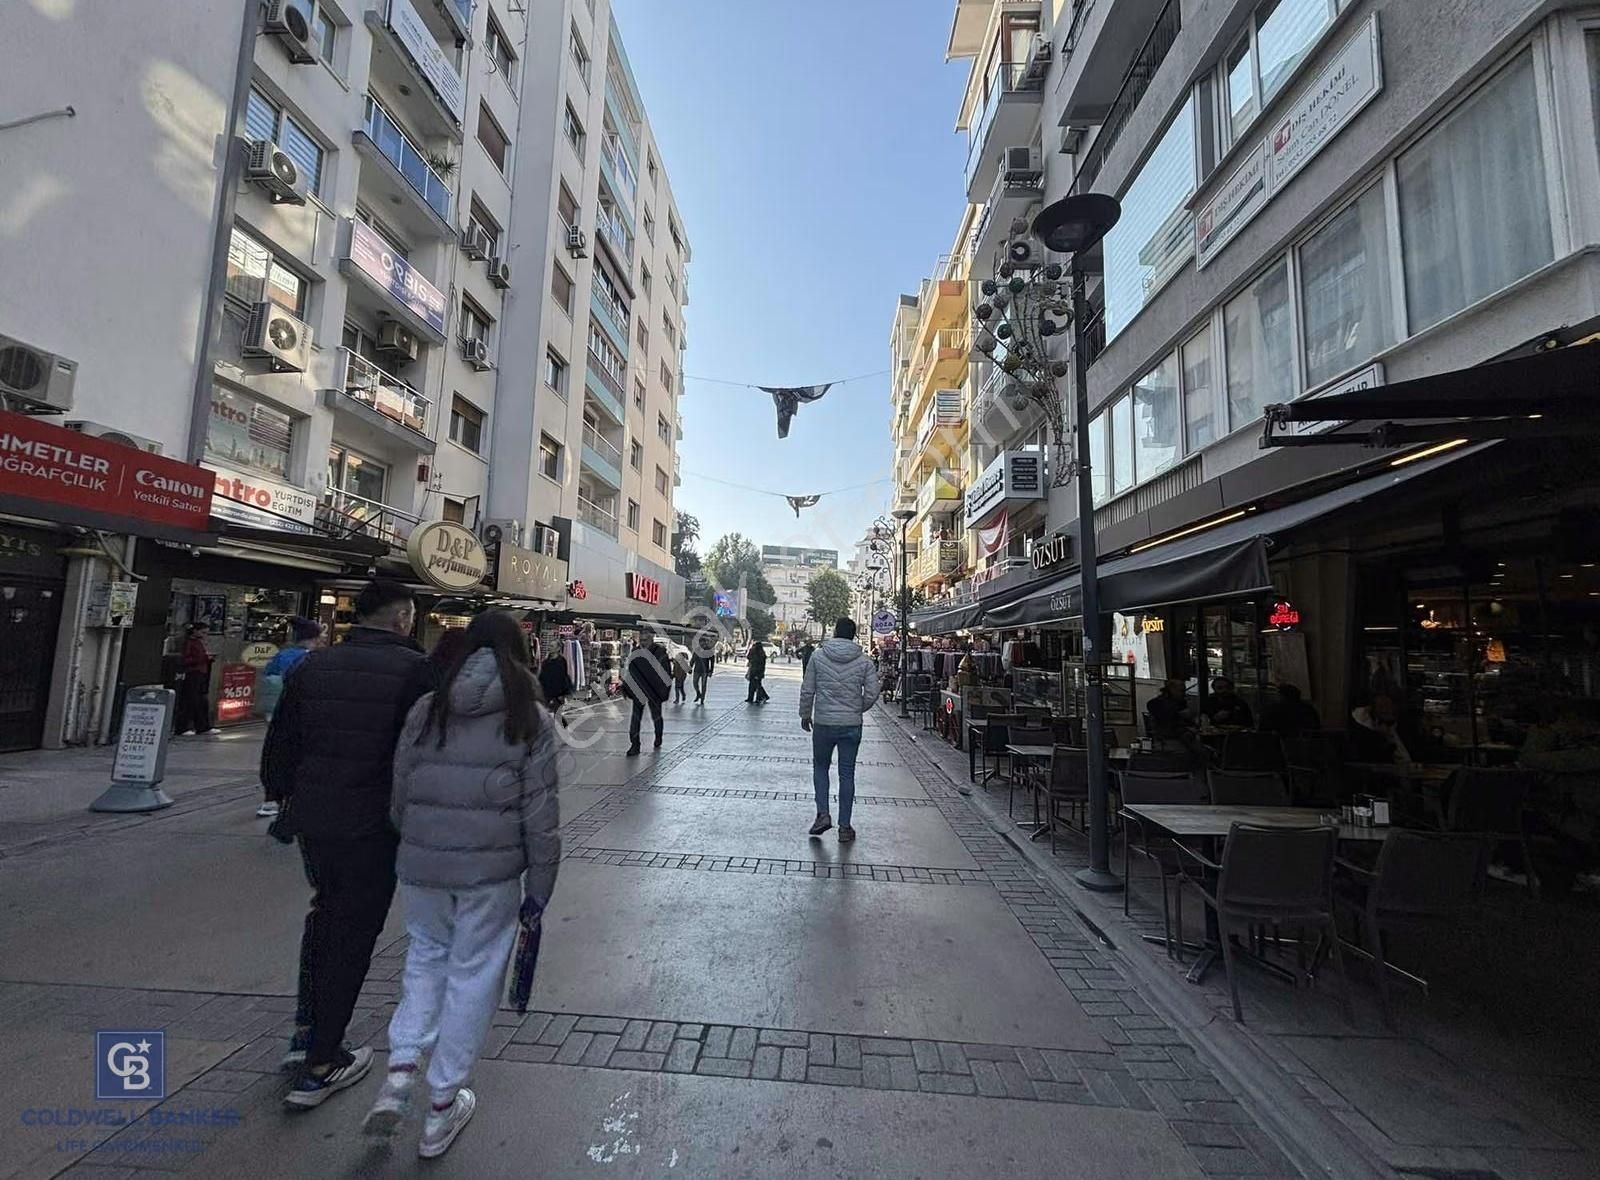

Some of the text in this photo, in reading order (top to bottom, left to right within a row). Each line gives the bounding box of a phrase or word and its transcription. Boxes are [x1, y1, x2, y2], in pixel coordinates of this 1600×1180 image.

[381, 252, 428, 301] ORBIS
[133, 490, 170, 507] Yetkili
[135, 469, 205, 499] Canon
[437, 528, 474, 561] D&P
[1032, 532, 1066, 570] ÖZSÜT
[511, 555, 558, 582] ROYAL
[224, 686, 251, 698] %50
